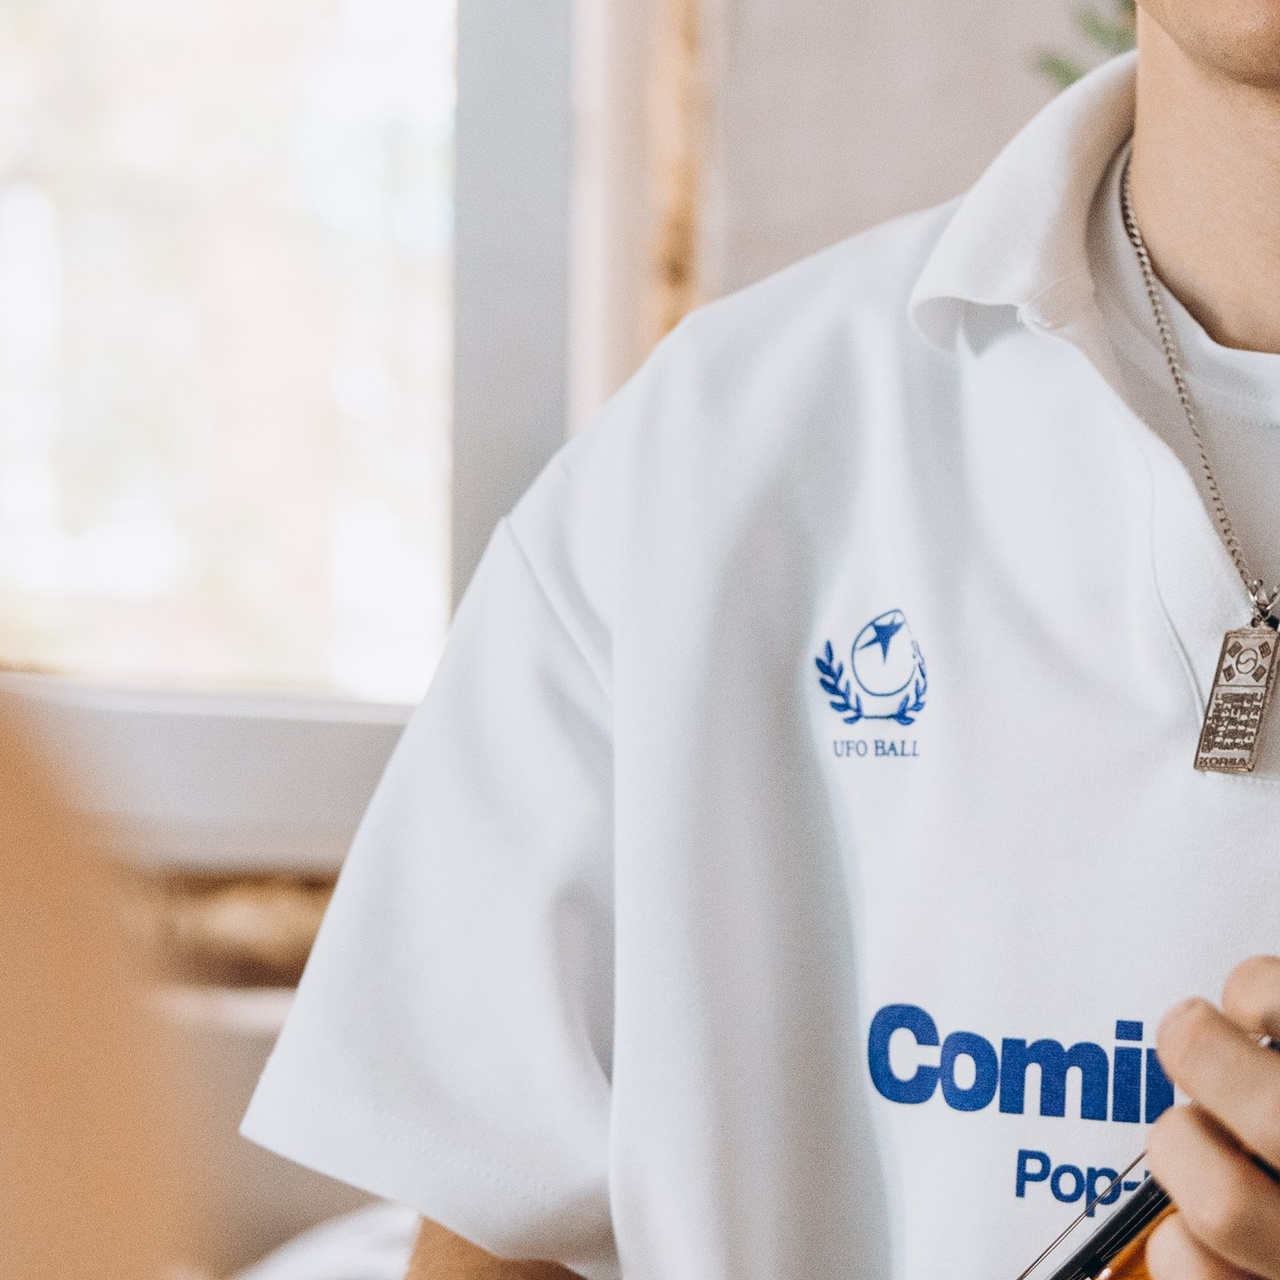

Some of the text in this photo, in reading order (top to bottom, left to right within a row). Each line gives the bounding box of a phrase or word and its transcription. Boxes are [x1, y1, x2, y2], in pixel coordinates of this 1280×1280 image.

[833, 739, 919, 757] UFO BALL
[868, 1003, 1175, 1124] Comi
[1015, 1149, 1151, 1218] Pop-
